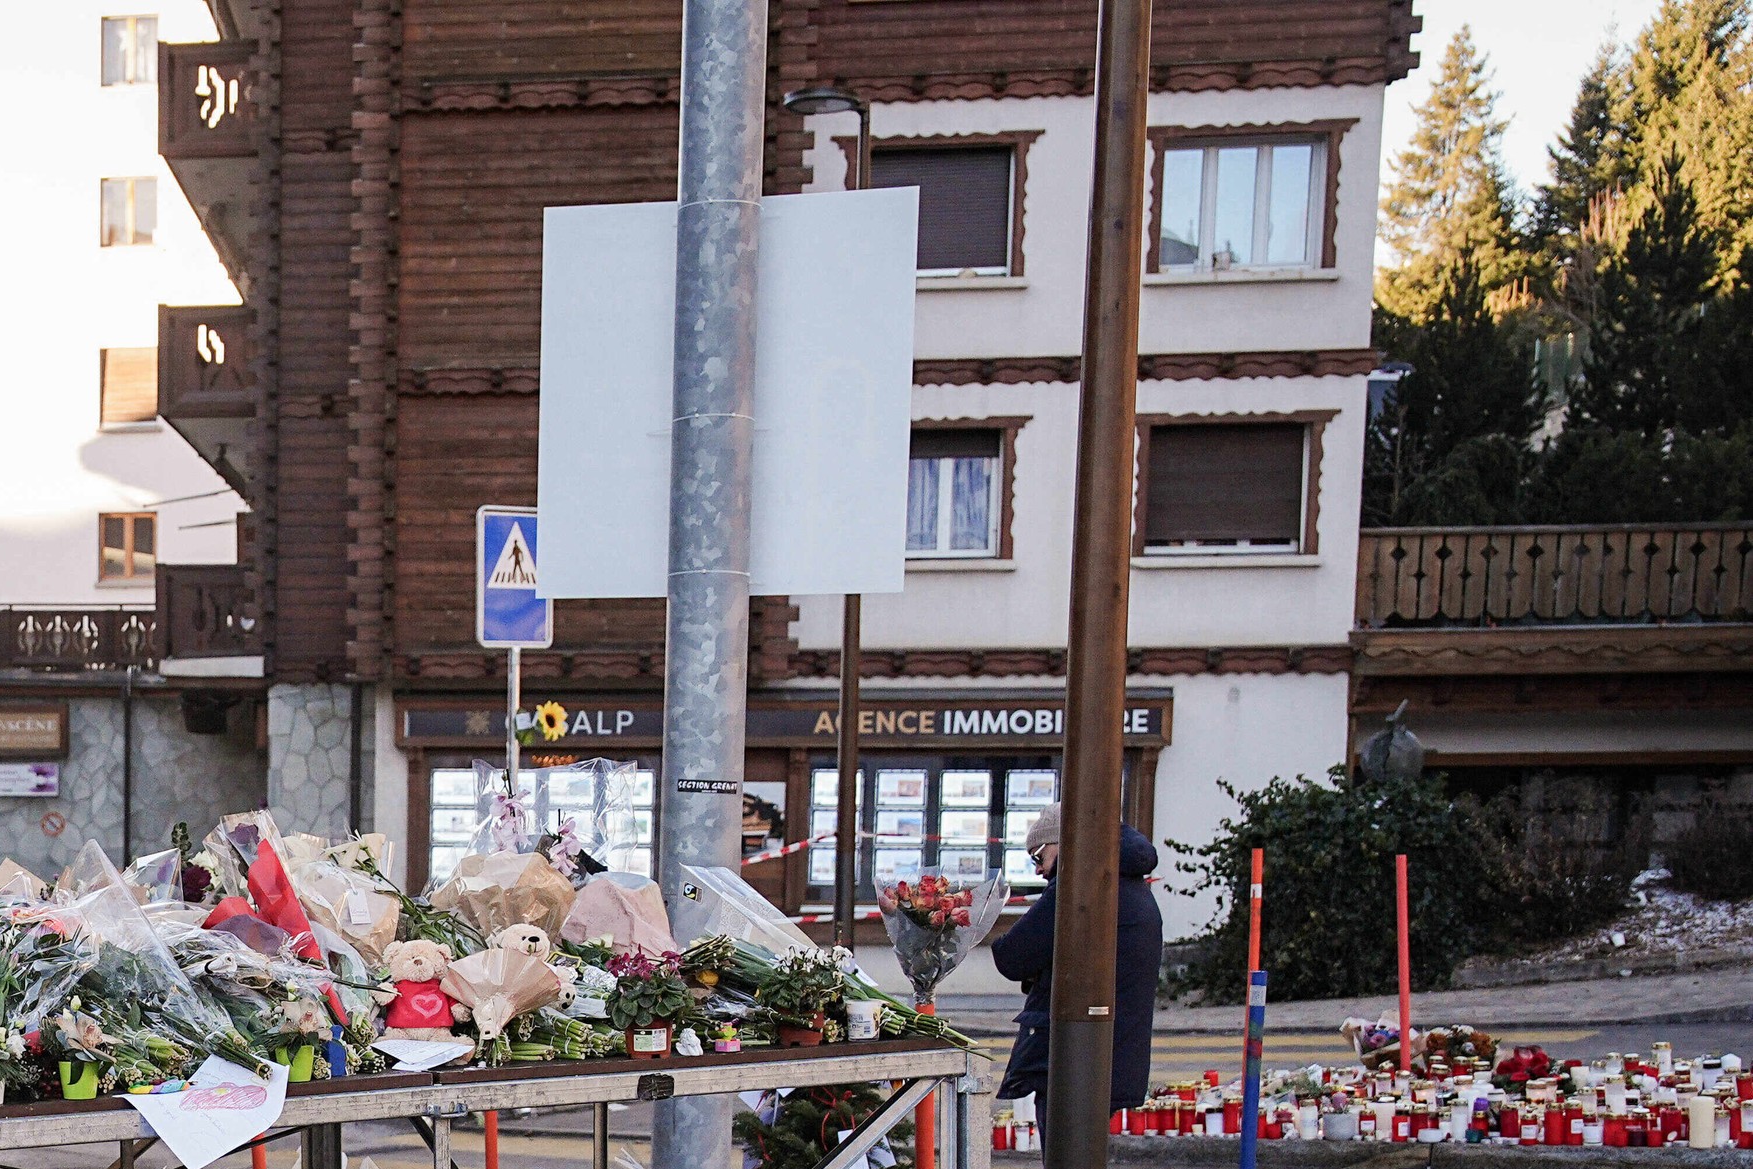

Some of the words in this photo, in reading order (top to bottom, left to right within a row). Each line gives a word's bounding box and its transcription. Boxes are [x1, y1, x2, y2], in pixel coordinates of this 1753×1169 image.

[505, 710, 634, 735] ALP
[814, 710, 936, 734] AENCE
[943, 709, 1150, 734] IMMOBIE
[678, 780, 709, 789] SECTION
